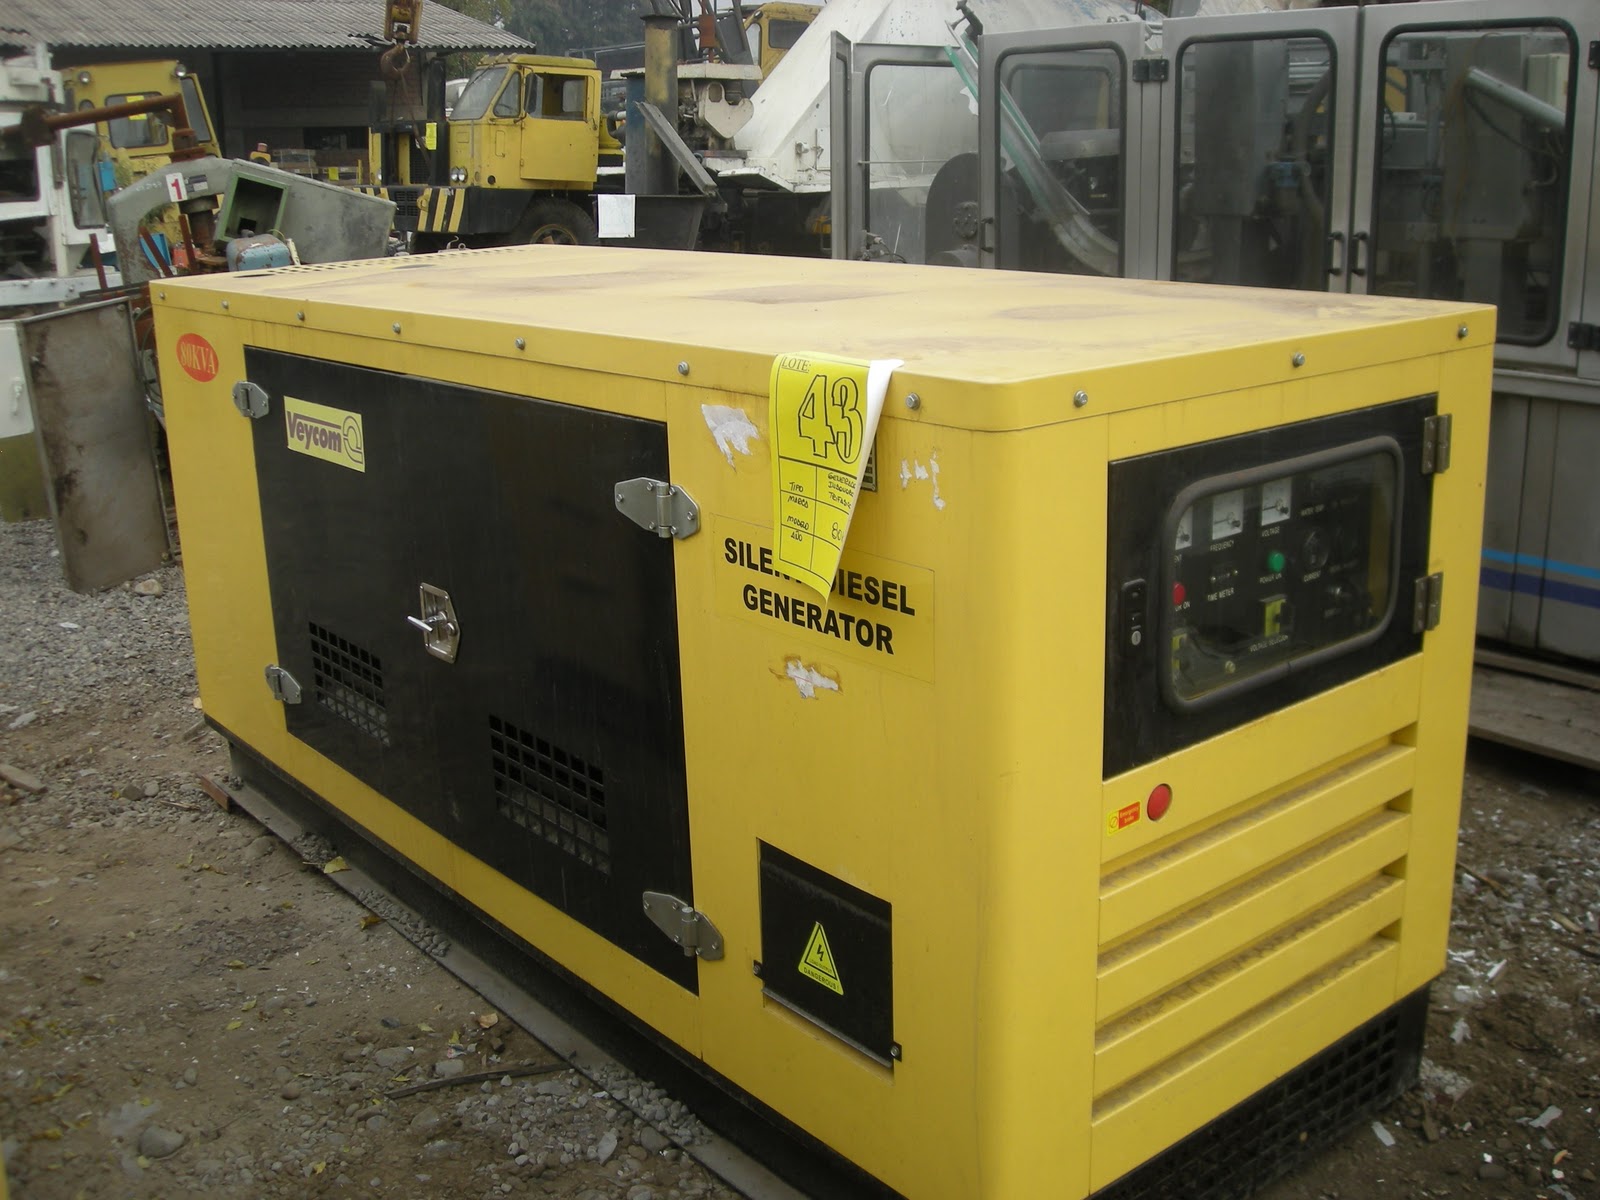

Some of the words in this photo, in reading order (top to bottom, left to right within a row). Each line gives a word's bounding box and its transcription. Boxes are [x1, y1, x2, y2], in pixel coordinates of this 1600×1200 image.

[171, 178, 183, 200] 1
[180, 342, 216, 375] 80KVA
[781, 356, 811, 373] LOTE:
[286, 410, 342, 453] Veycom
[797, 374, 864, 465] 43
[789, 481, 804, 493] TIPO
[1210, 540, 1234, 551] FREQUENCY
[830, 569, 916, 617] IESEL
[743, 583, 894, 655] GENERATOR
